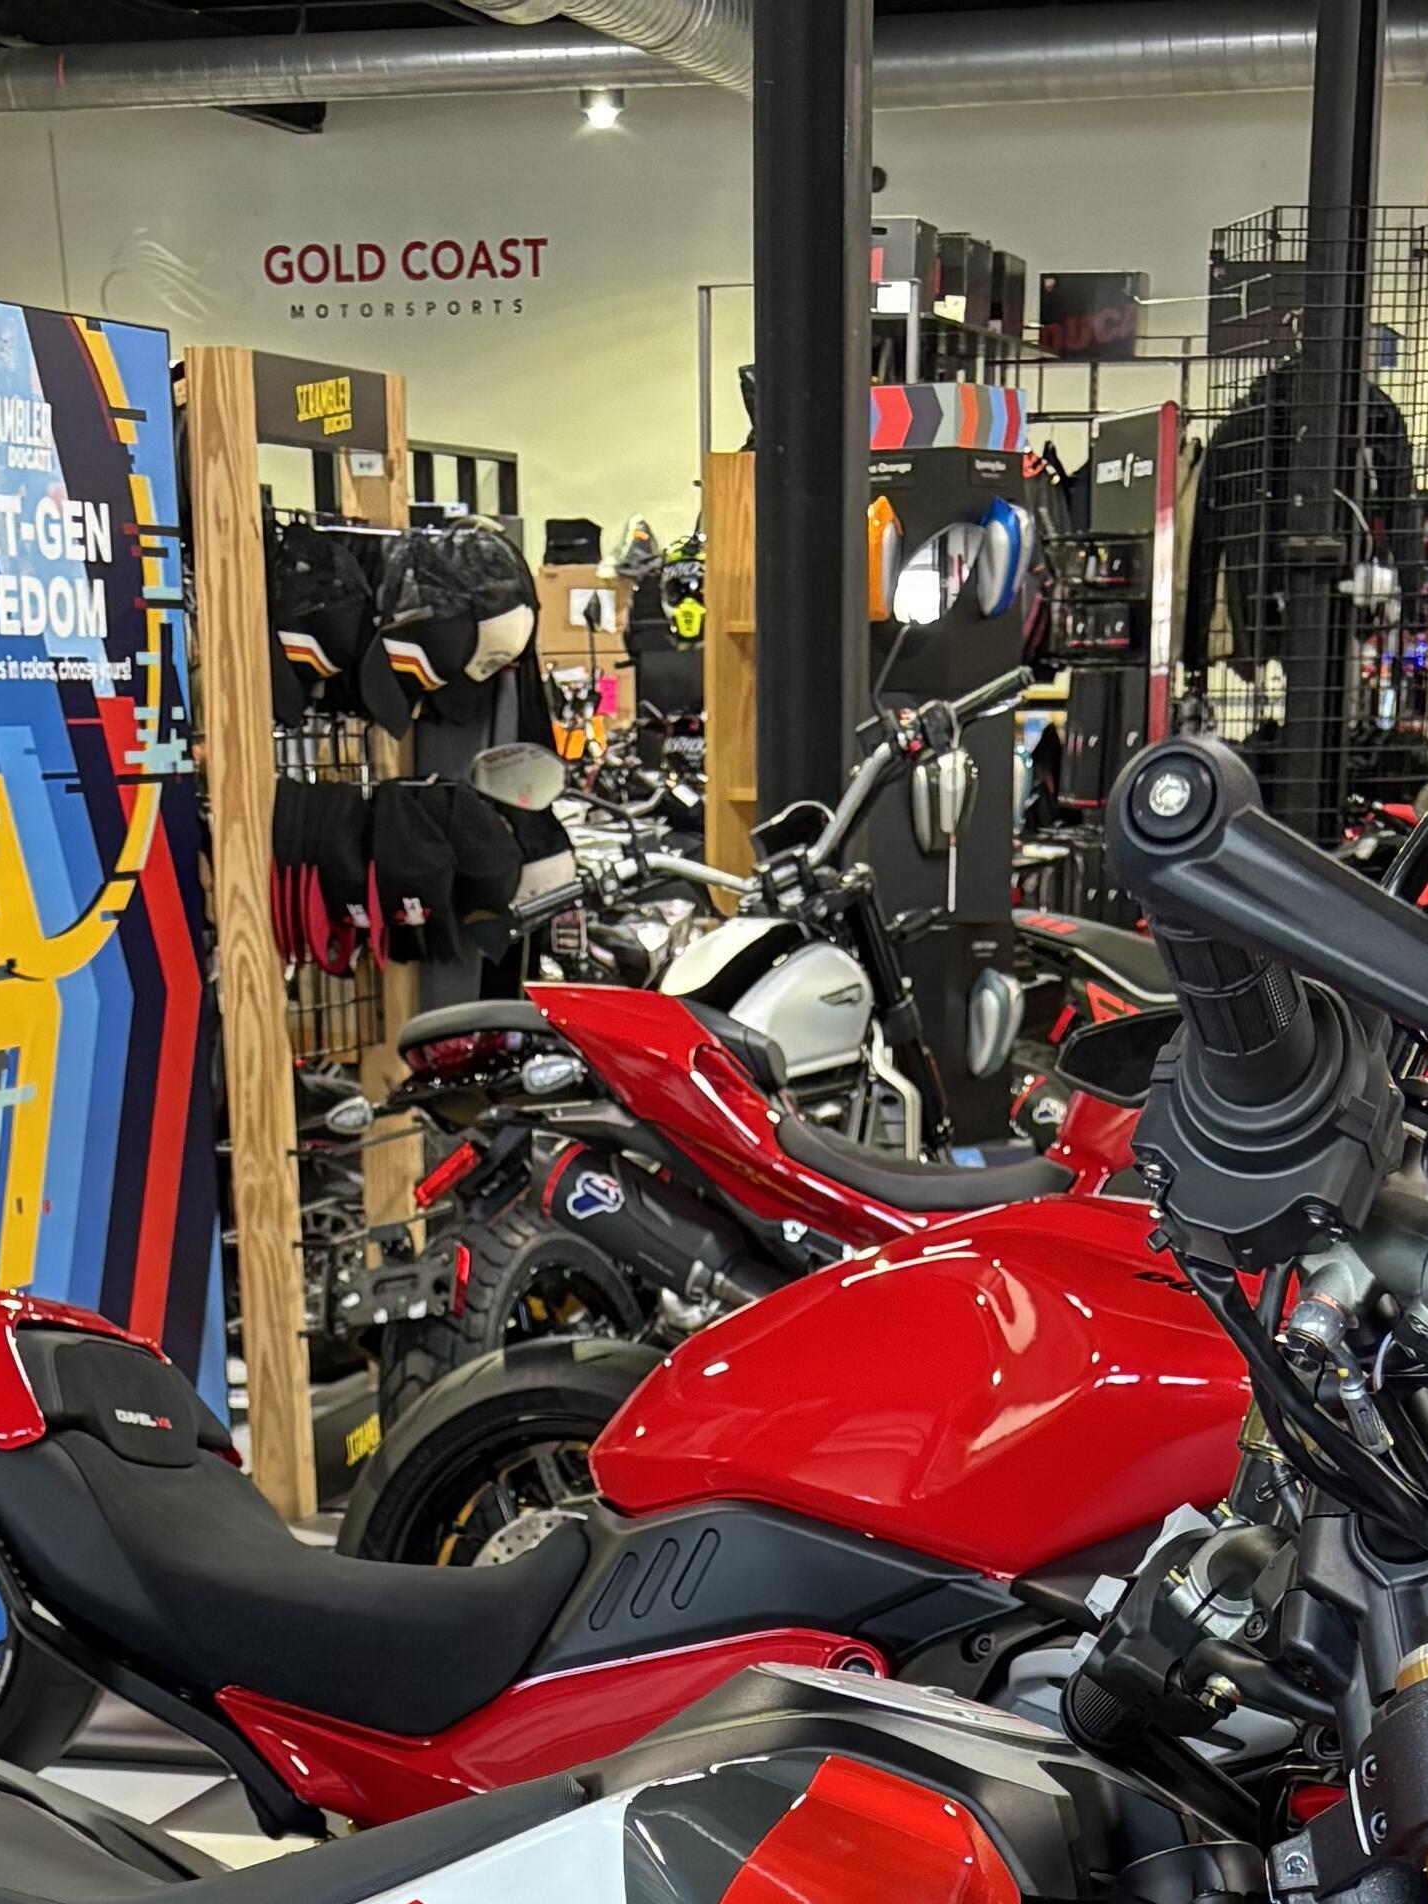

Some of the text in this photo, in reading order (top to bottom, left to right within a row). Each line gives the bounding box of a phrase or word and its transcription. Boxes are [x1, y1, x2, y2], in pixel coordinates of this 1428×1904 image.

[264, 238, 548, 285] GOLD COAST
[290, 299, 524, 319] MOTORSPORTS
[7, 446, 53, 472] DUCATI
[7, 656, 20, 680] in
